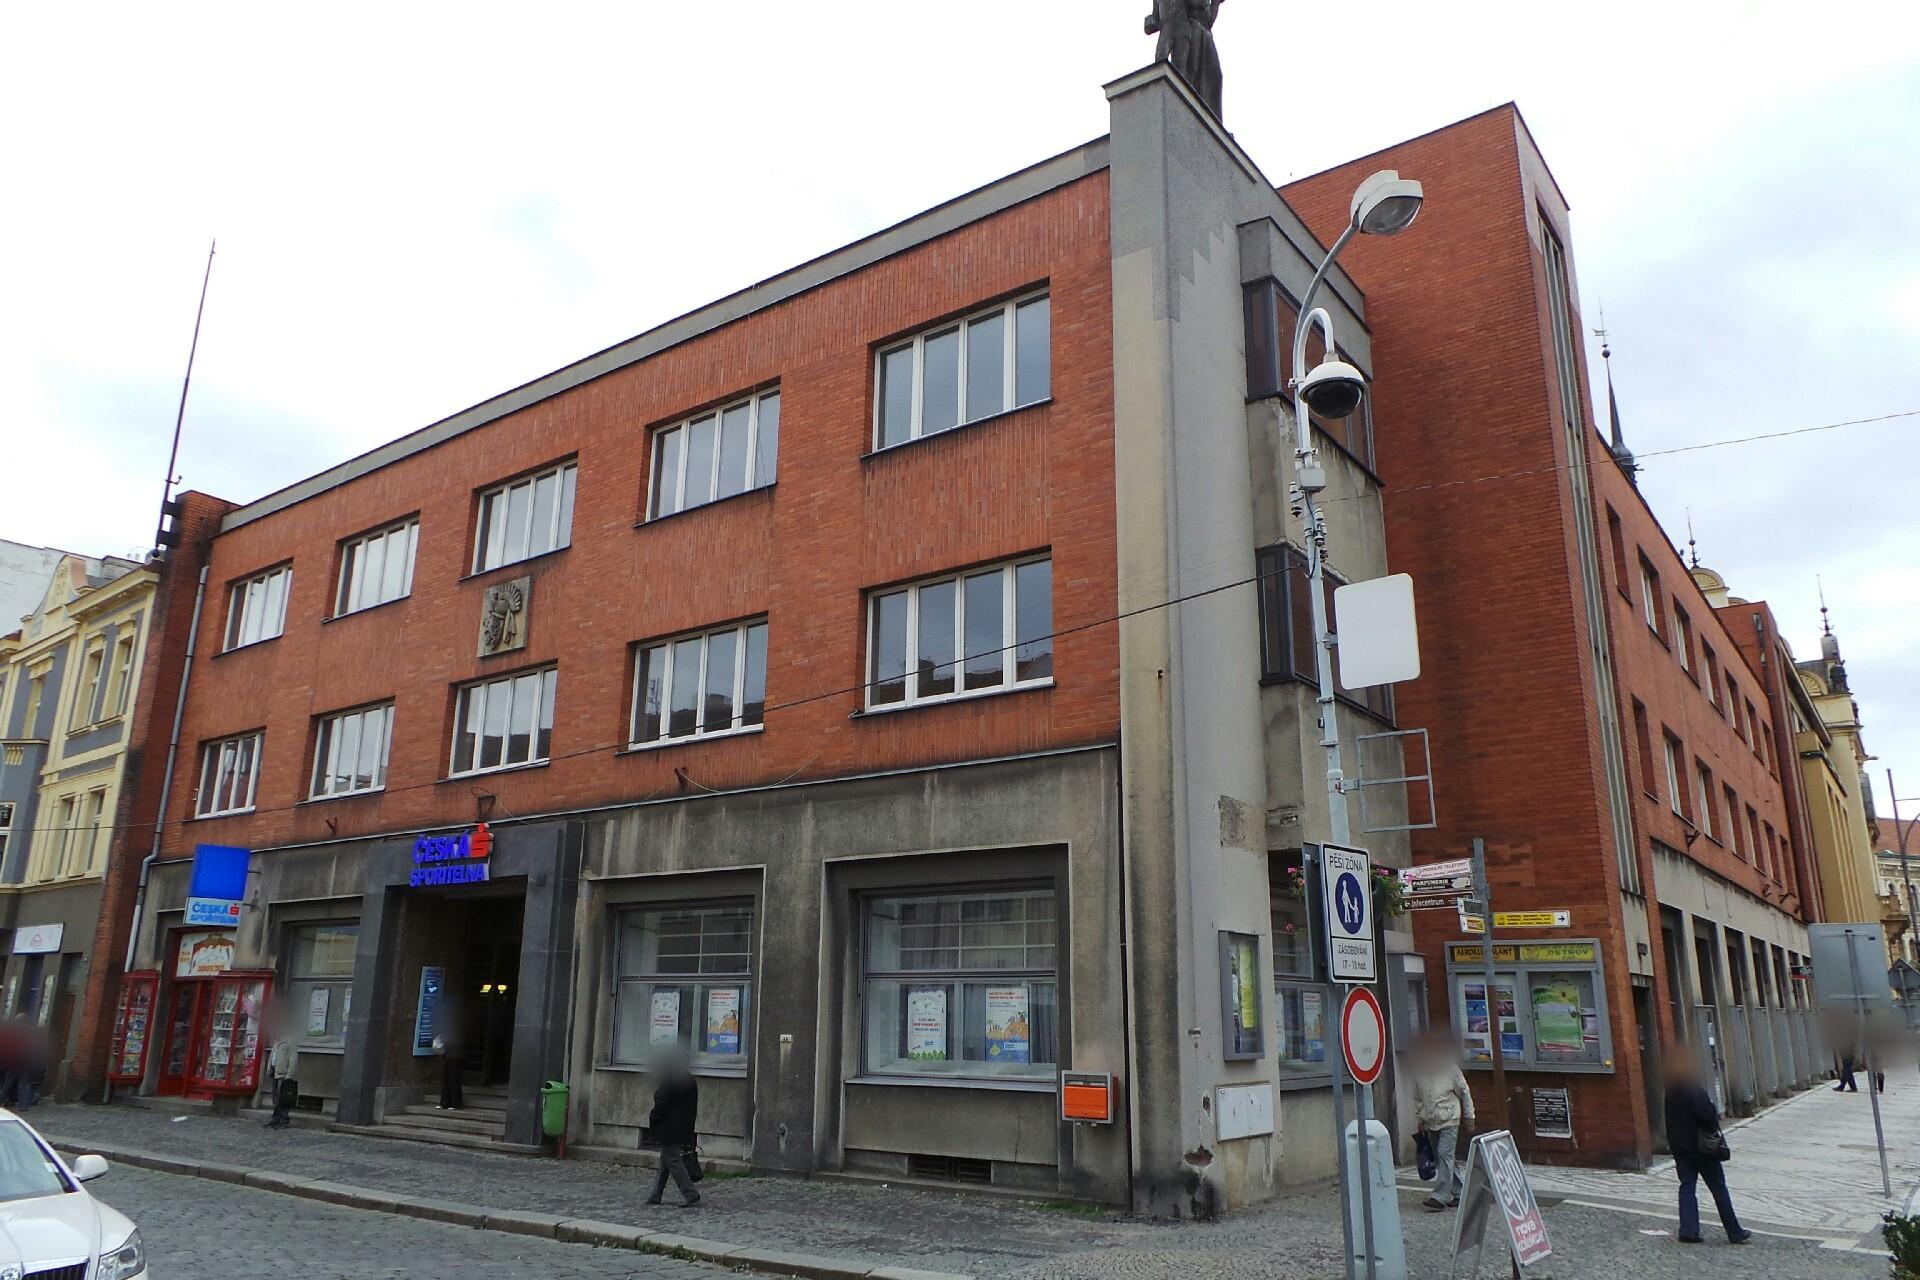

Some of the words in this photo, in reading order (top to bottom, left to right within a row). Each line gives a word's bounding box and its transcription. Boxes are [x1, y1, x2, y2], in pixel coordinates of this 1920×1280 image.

[412, 829, 470, 864] ČESKÁ
[1329, 853, 1345, 869] PĚŠÍ
[1345, 856, 1364, 872] ZÓNA
[1411, 898, 1445, 908] Infocentrum
[1337, 943, 1368, 956] ZÁSOBOVÁNÍ
[1547, 948, 1589, 956] OSTROV
